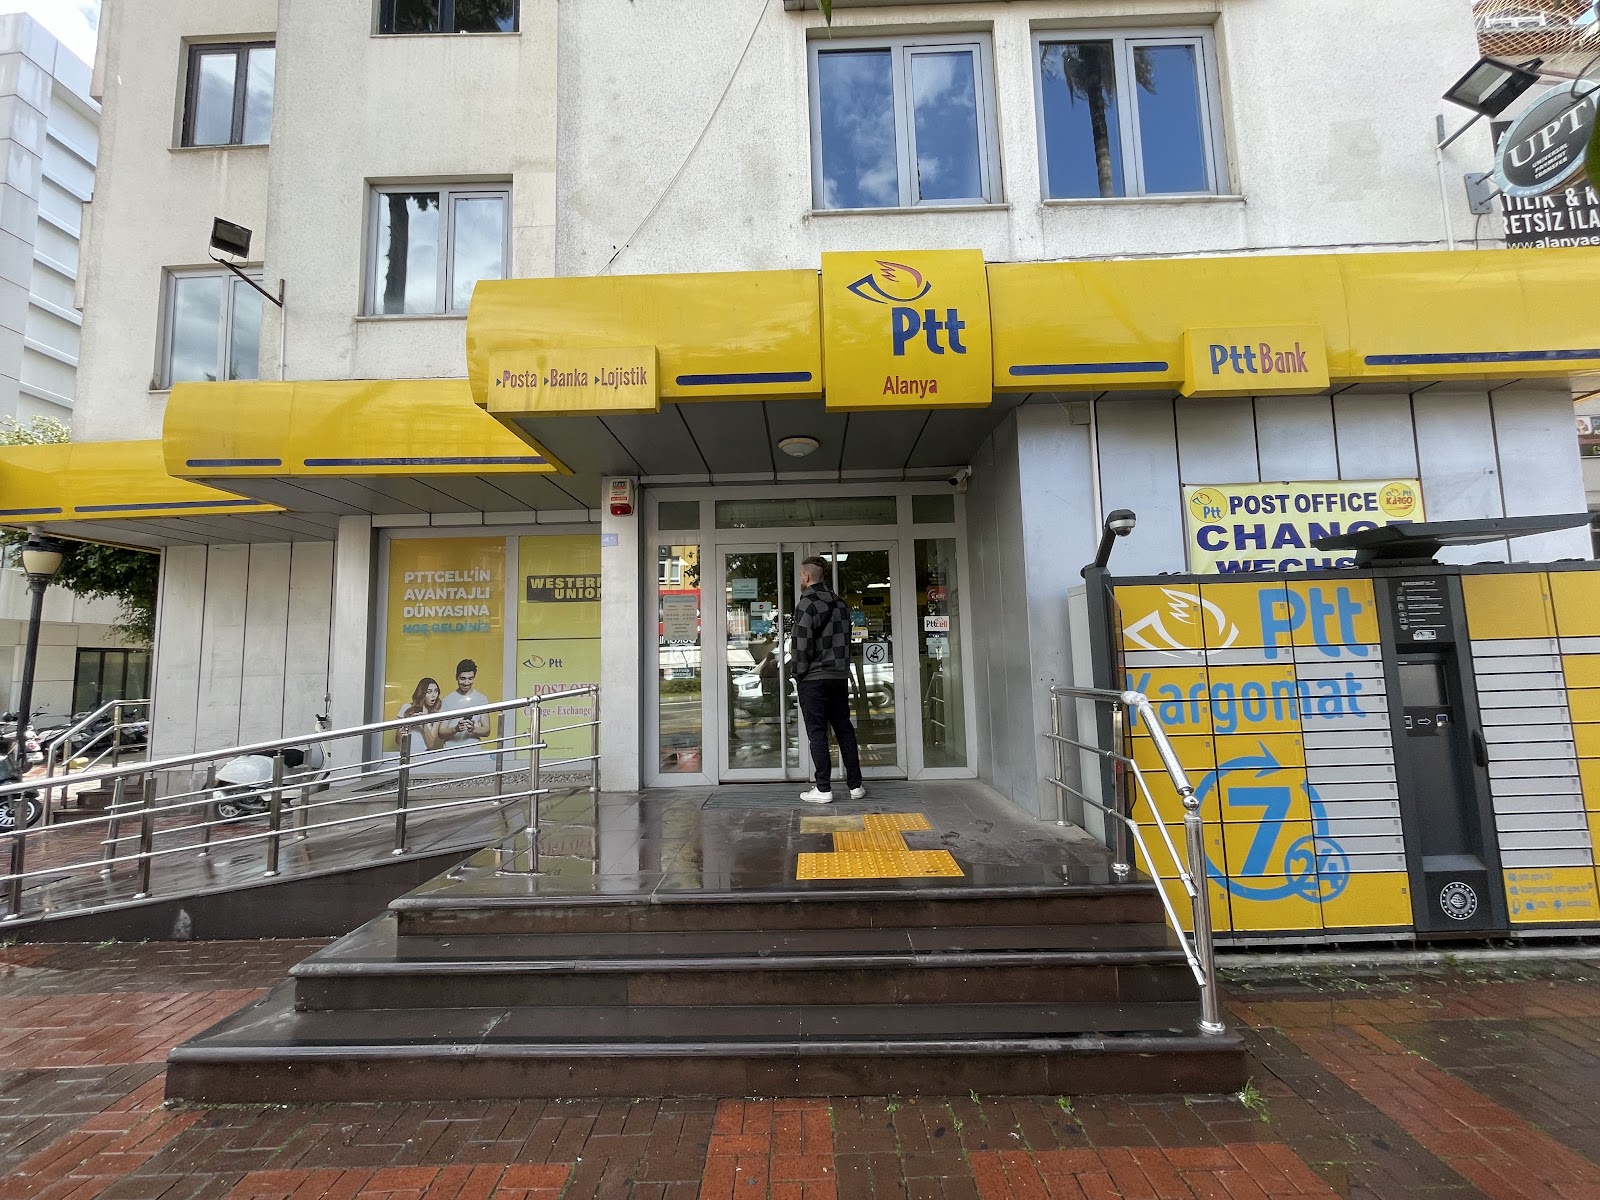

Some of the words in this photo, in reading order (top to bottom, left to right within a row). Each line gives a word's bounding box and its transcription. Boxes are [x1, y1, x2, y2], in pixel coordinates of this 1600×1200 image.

[1507, 100, 1587, 167] UPT
[1565, 187, 1580, 207] &
[892, 307, 967, 356] Ptt
[502, 370, 538, 389] Posta
[550, 368, 588, 388] Banka
[601, 366, 648, 389] Lojistik
[883, 375, 938, 399] Alanya
[1203, 505, 1222, 519] Ptt
[1229, 494, 1290, 515] POST
[1294, 492, 1379, 514] OFFICE
[1196, 520, 1414, 551] CHAN
[404, 566, 491, 584] PTTCELL'İN
[403, 587, 491, 601] AVANTAJLI
[403, 602, 490, 618] DÜNYASINA
[1258, 586, 1369, 660] Ptt
[548, 658, 563, 668] Ptt
[557, 705, 592, 718] Exchange
[1126, 672, 1367, 734] Kargomat
[1227, 786, 1292, 877] 7
[1291, 848, 1345, 893] 24
